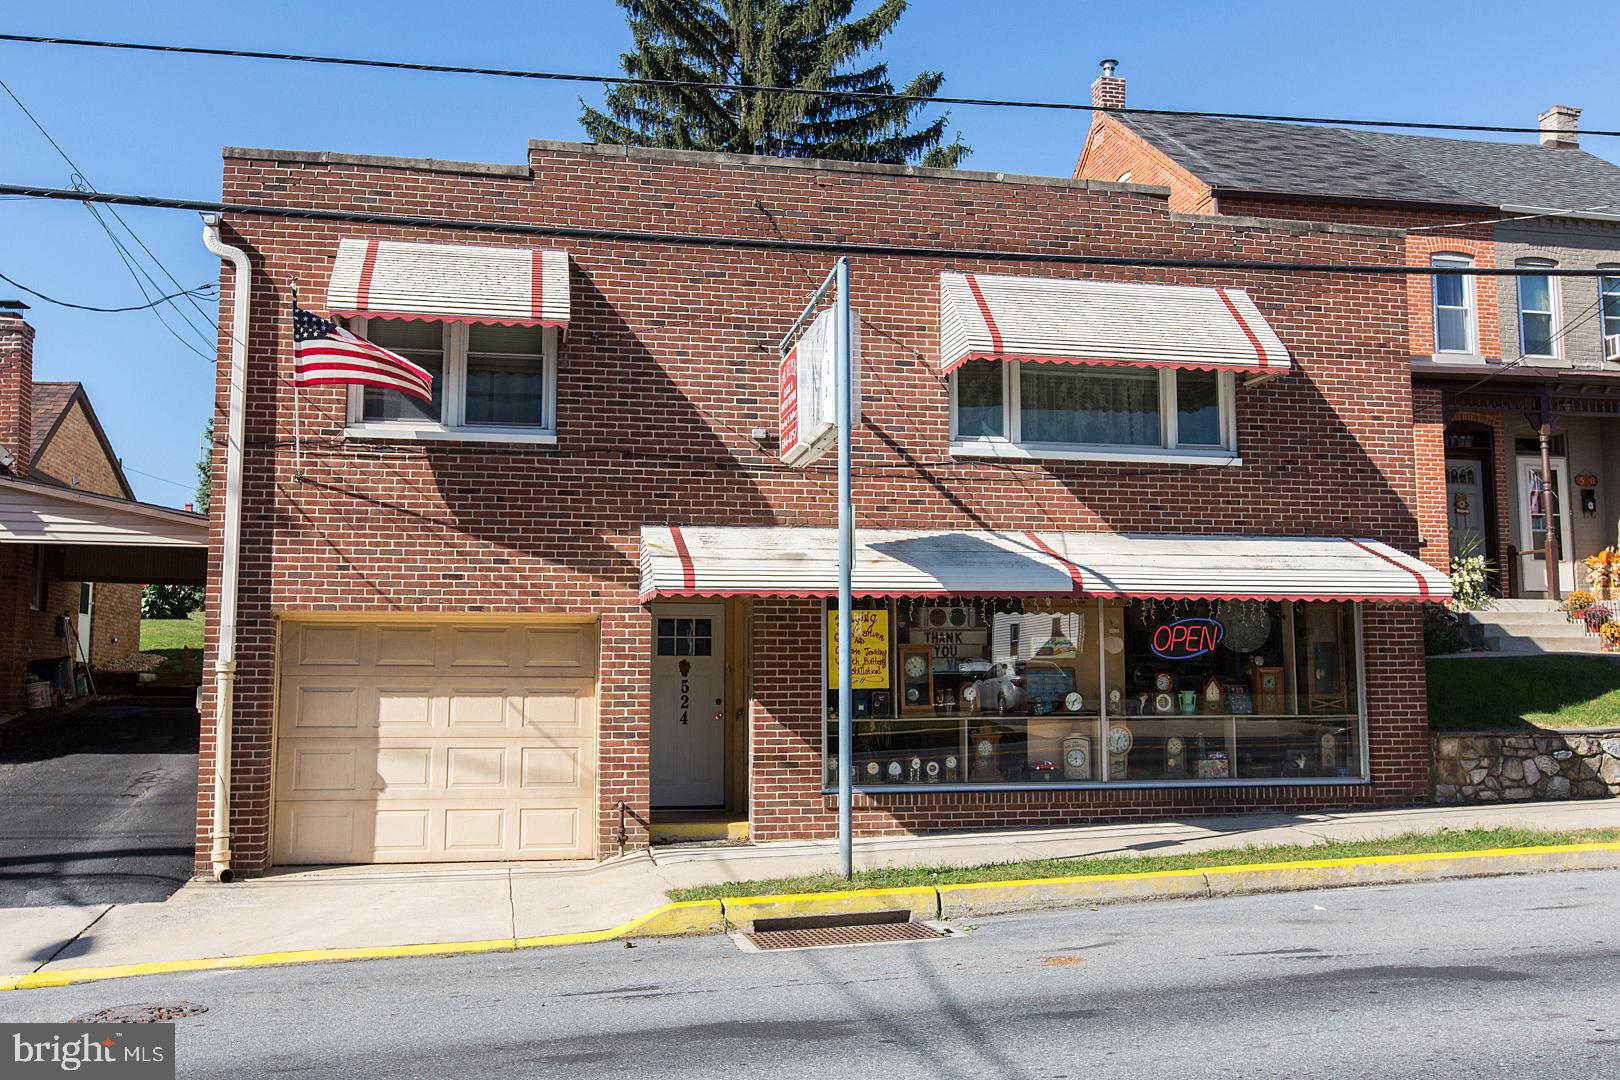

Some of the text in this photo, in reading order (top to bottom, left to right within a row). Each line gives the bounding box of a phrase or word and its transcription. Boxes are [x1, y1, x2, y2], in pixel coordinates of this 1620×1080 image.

[924, 631, 962, 644] THANK
[1153, 625, 1218, 652] OPEN
[934, 645, 958, 657] YOU
[680, 679, 689, 724] 524
